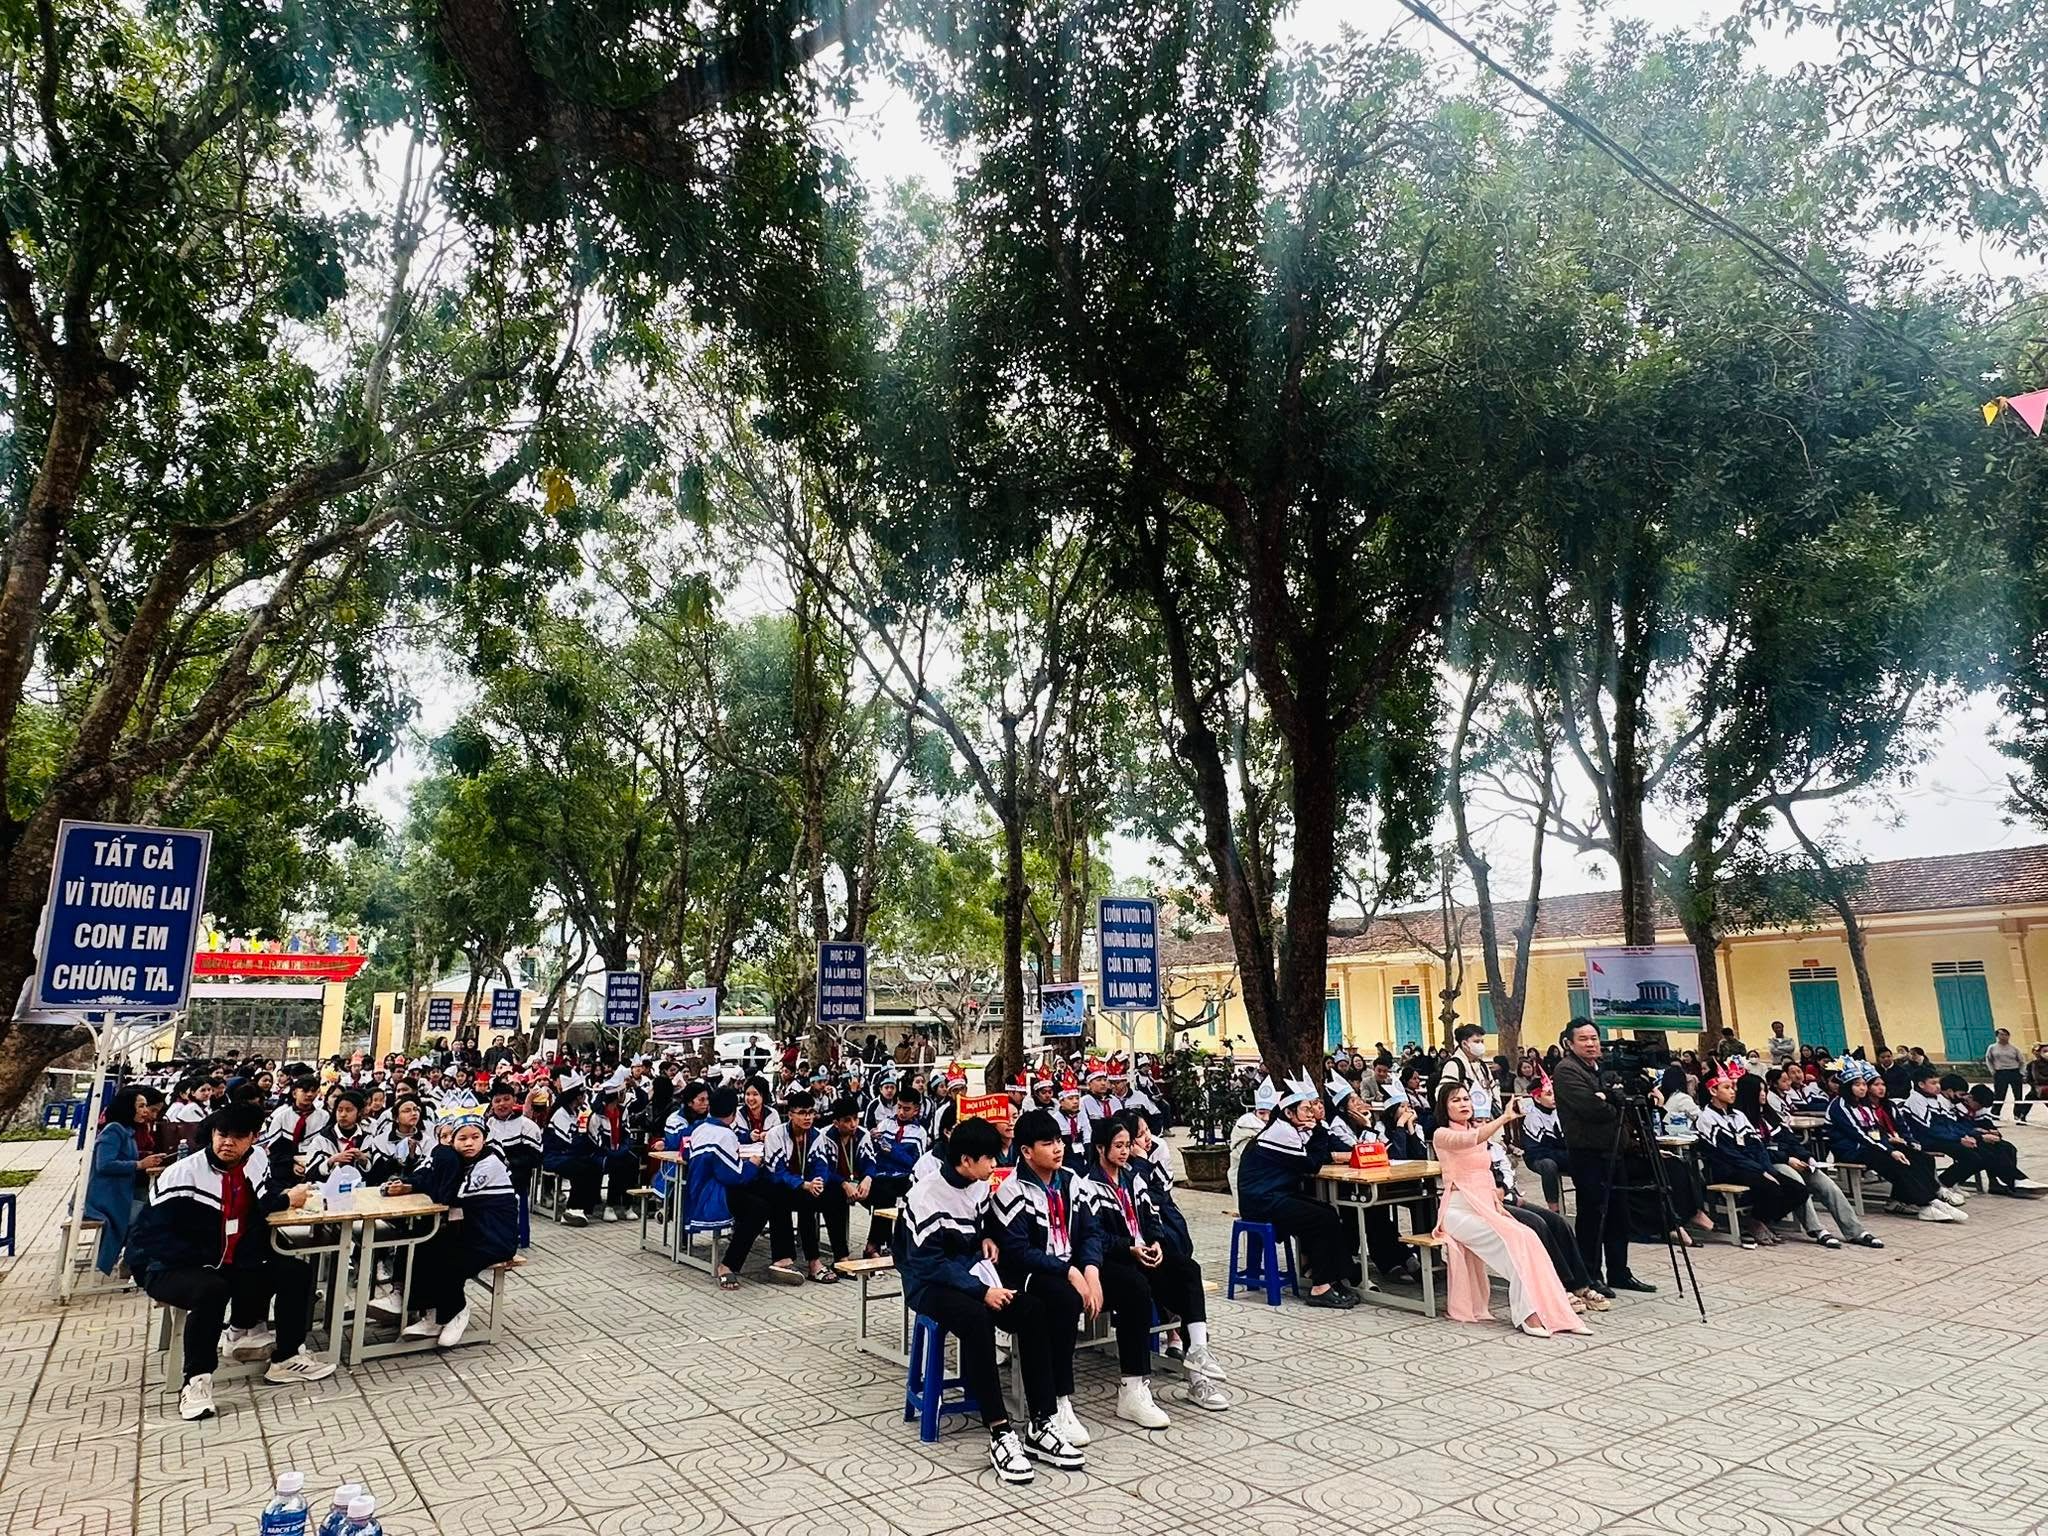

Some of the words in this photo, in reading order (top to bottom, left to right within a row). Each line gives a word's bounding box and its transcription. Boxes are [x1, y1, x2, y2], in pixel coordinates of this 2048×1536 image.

[94, 835, 137, 867] TẤT
[143, 838, 174, 870] CẢ
[65, 876, 85, 905] VÌ
[91, 881, 155, 909] TƯƠNG
[159, 886, 190, 910] LAI
[1104, 905, 1121, 923] LUÔN
[74, 923, 126, 949] CON
[131, 925, 169, 950] EM
[1142, 933, 1153, 949] CAO
[830, 950, 843, 963] HỌC
[844, 948, 856, 963] TẬP
[1108, 952, 1121, 972] CỦA
[1123, 958, 1133, 972] TRI
[1135, 955, 1151, 973] THỨC
[52, 960, 137, 991] CHÚNG
[144, 967, 174, 991] TA.
[825, 964, 832, 978] VÀ
[833, 964, 845, 978] LÀM
[847, 968, 861, 979] THEO
[1108, 980, 1118, 998] VÀ
[1119, 982, 1137, 998] KHOA
[1139, 983, 1152, 1001] HỌC
[823, 1001, 831, 1014] HỒ
[832, 1002, 842, 1014] CHÍ
